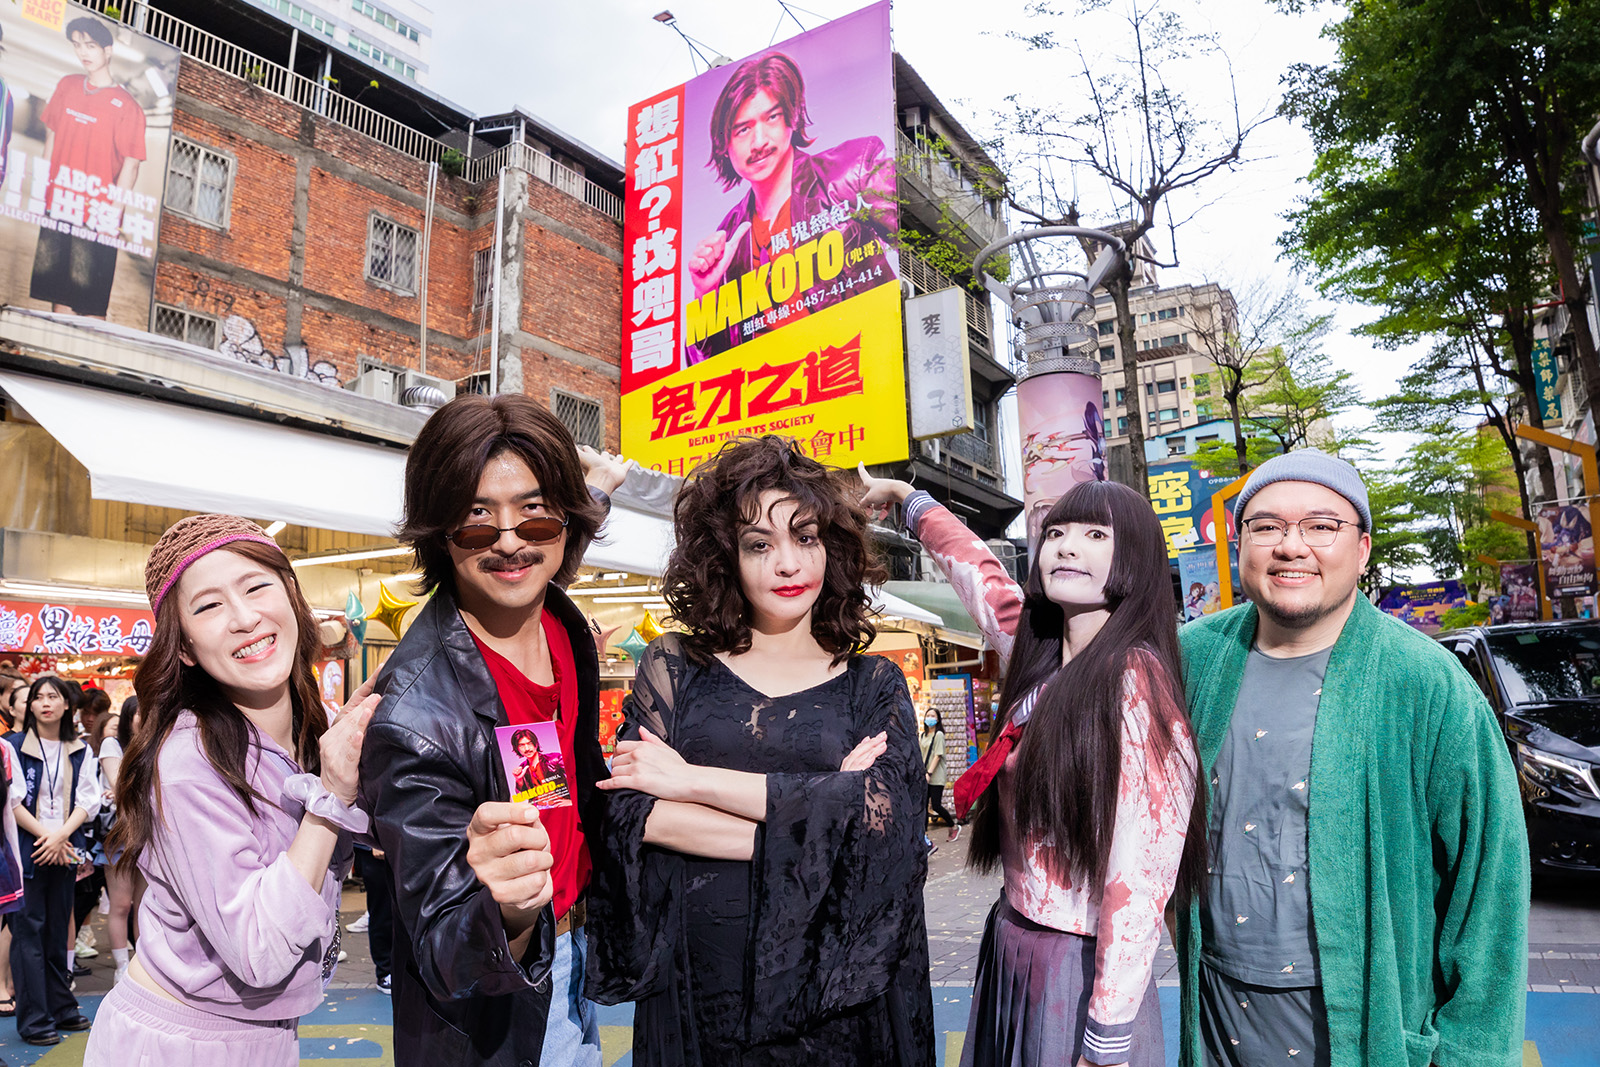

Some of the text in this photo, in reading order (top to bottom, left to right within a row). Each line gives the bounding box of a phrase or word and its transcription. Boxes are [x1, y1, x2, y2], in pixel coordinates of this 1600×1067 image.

[25, 4, 60, 25] MART
[54, 165, 156, 213] ABC-MART
[58, 221, 71, 234] IS
[71, 226, 97, 242] NOW
[97, 234, 152, 258] AVAILABLE
[686, 230, 844, 347] MAKOTO
[650, 331, 865, 442] 鬼才之道
[688, 434, 716, 448] DEAD
[769, 413, 815, 431] SOCIETY
[512, 781, 556, 803] MAKOTO
